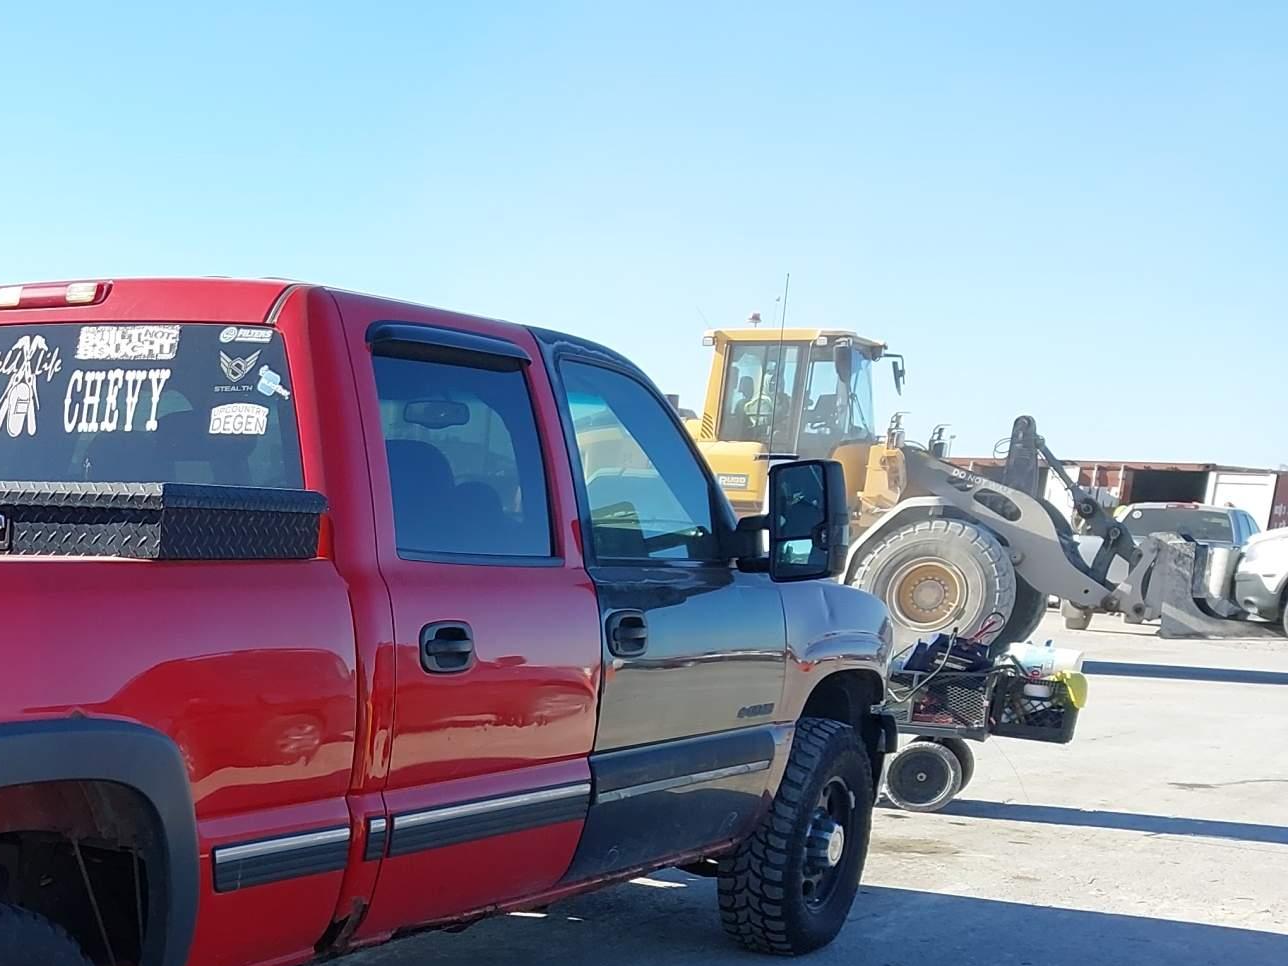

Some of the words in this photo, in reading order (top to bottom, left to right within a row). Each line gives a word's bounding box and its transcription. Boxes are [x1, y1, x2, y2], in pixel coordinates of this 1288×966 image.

[214, 385, 253, 393] STEALTH
[63, 368, 171, 433] CHEVY
[213, 405, 268, 416] UPCOUNTRY
[211, 415, 265, 431] DEGEN
[952, 468, 966, 479] DO
